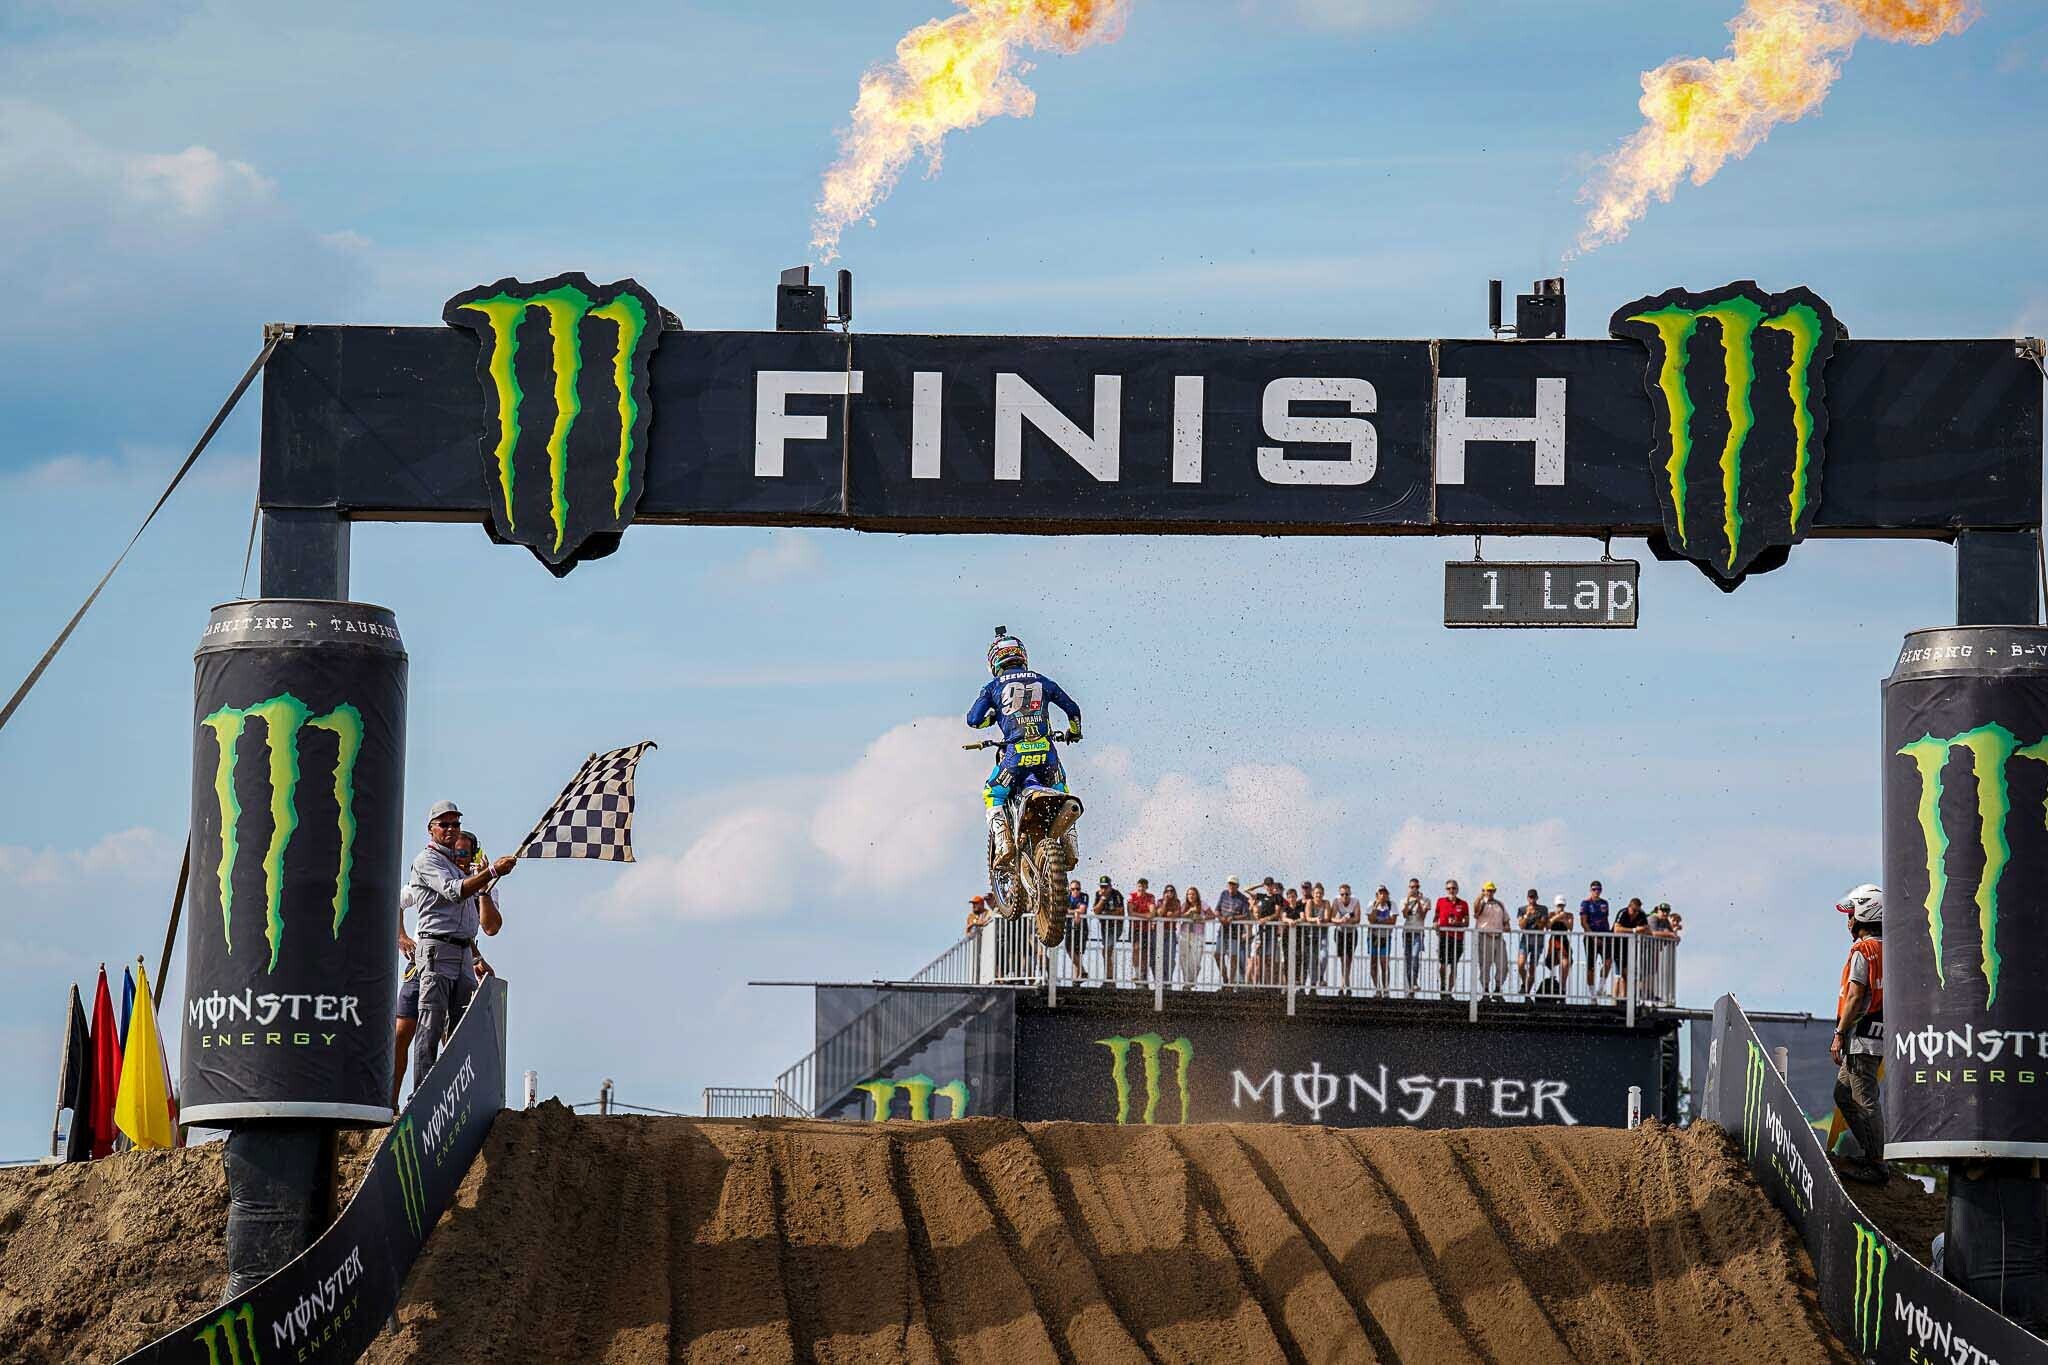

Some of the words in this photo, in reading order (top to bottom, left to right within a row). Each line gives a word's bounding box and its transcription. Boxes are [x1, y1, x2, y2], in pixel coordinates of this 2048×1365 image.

[754, 371, 1566, 487] FINISH
[1482, 571, 1504, 609] 1
[1543, 571, 1634, 621] Lap
[1900, 645, 1973, 664] GINSENG
[1001, 681, 1042, 716] 91
[1017, 753, 1047, 767] JS91
[188, 987, 363, 1030] MONSTER
[202, 1032, 337, 1048] ENERGY
[421, 1053, 476, 1156] MONSTER
[1232, 1062, 1579, 1126] MONSTER
[1915, 1069, 2048, 1084] ENERG
[435, 1101, 473, 1169] ENERGY
[1765, 1102, 1814, 1211] MONSTER
[271, 1244, 365, 1350] MONSTER
[297, 1295, 359, 1363] ENERGY
[1894, 1292, 2001, 1365] MONST
